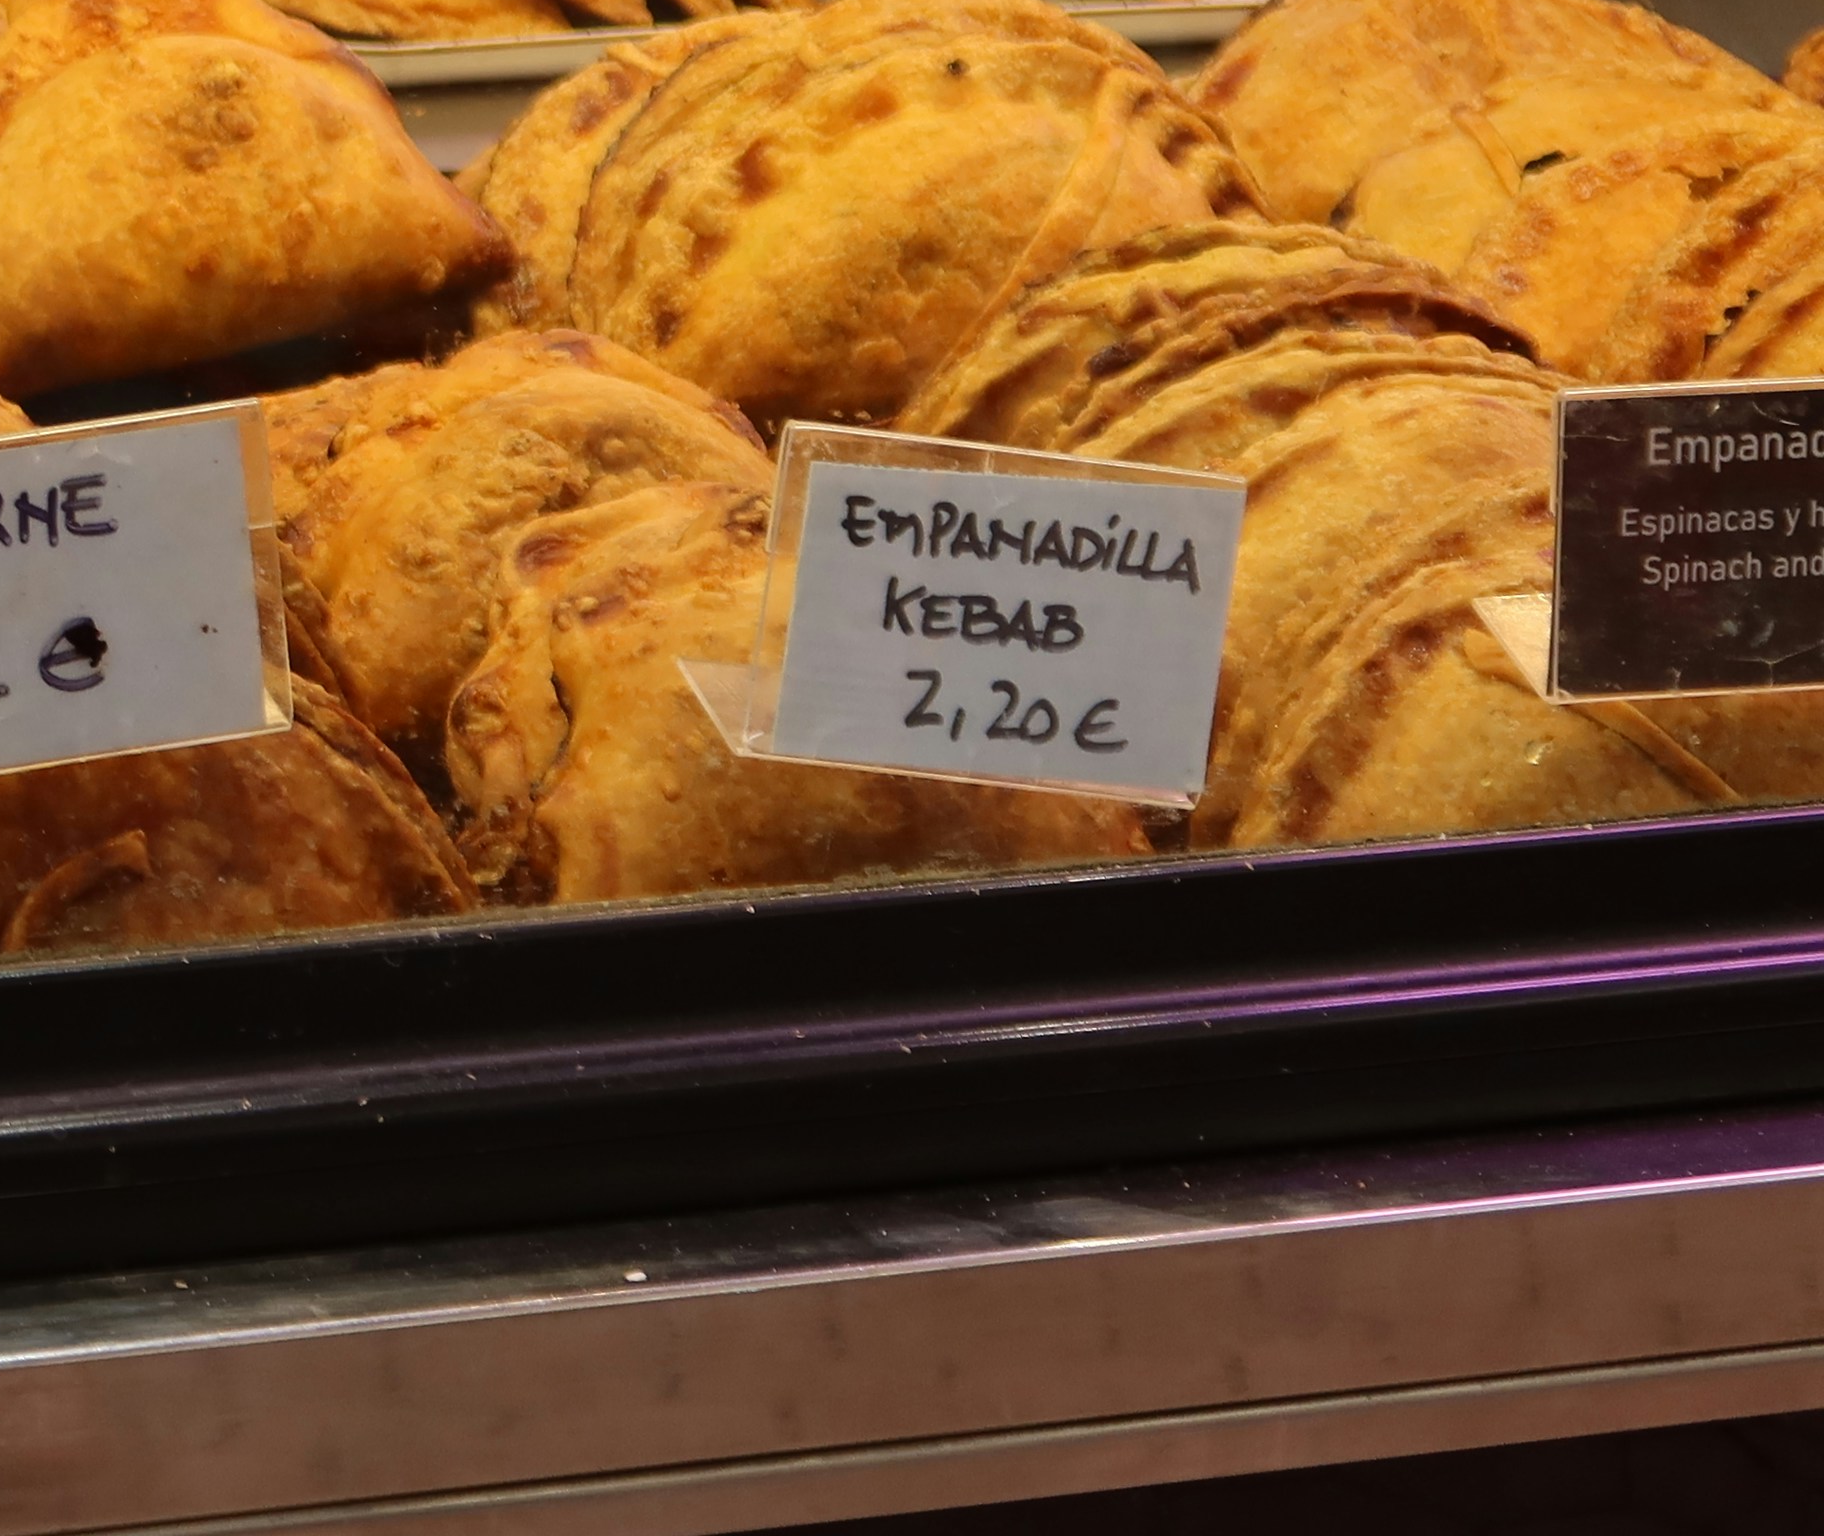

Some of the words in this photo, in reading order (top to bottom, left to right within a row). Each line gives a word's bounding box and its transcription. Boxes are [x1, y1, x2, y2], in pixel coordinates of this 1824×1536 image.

[1621, 506, 1774, 543] Espinacas
[1783, 507, 1801, 537] y
[1642, 551, 1763, 592] Spinach
[1772, 546, 1824, 578] and
[881, 575, 1085, 654] KEBAB
